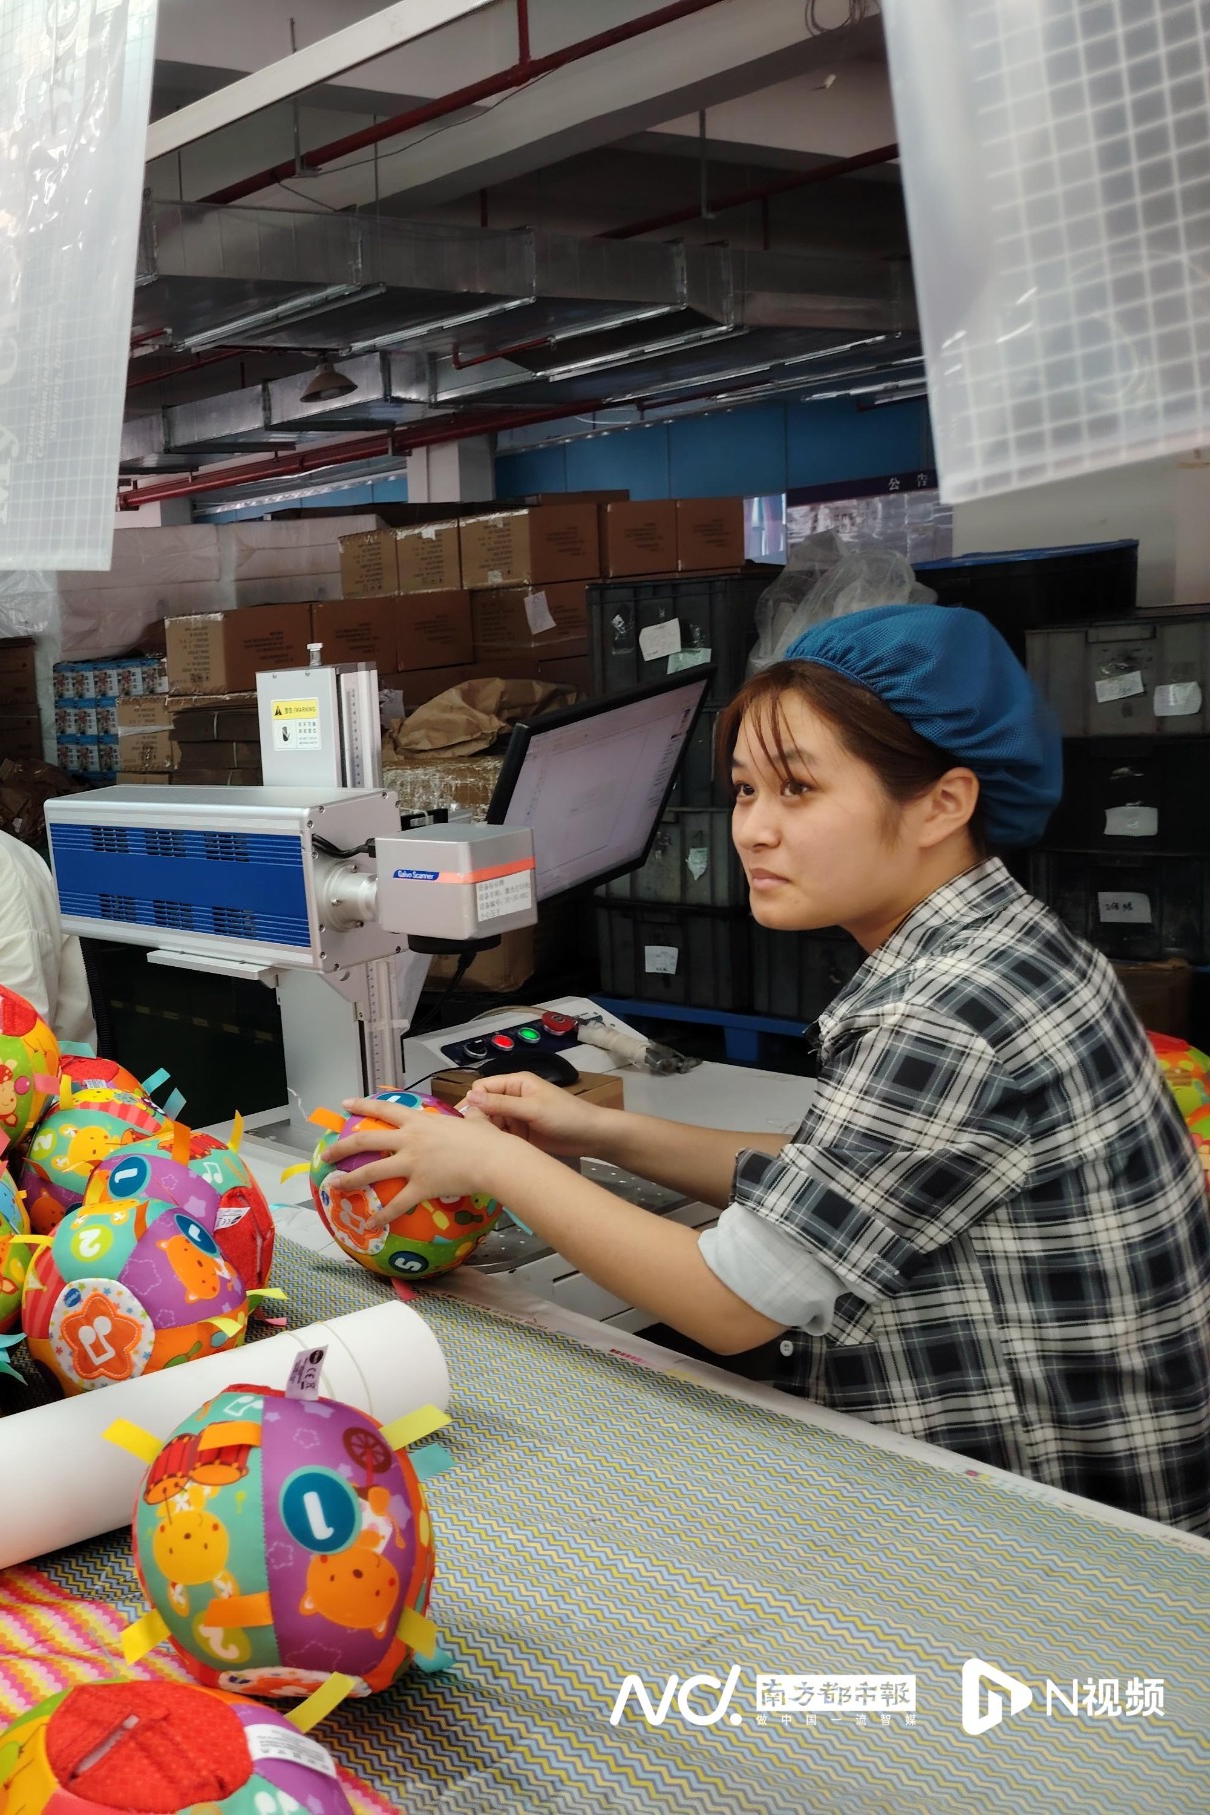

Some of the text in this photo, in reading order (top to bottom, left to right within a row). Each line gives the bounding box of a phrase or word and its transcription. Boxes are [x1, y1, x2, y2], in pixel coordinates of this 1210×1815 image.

[412, 871, 435, 880] Scanner
[79, 1229, 102, 1258] 2
[303, 1491, 334, 1540] 1
